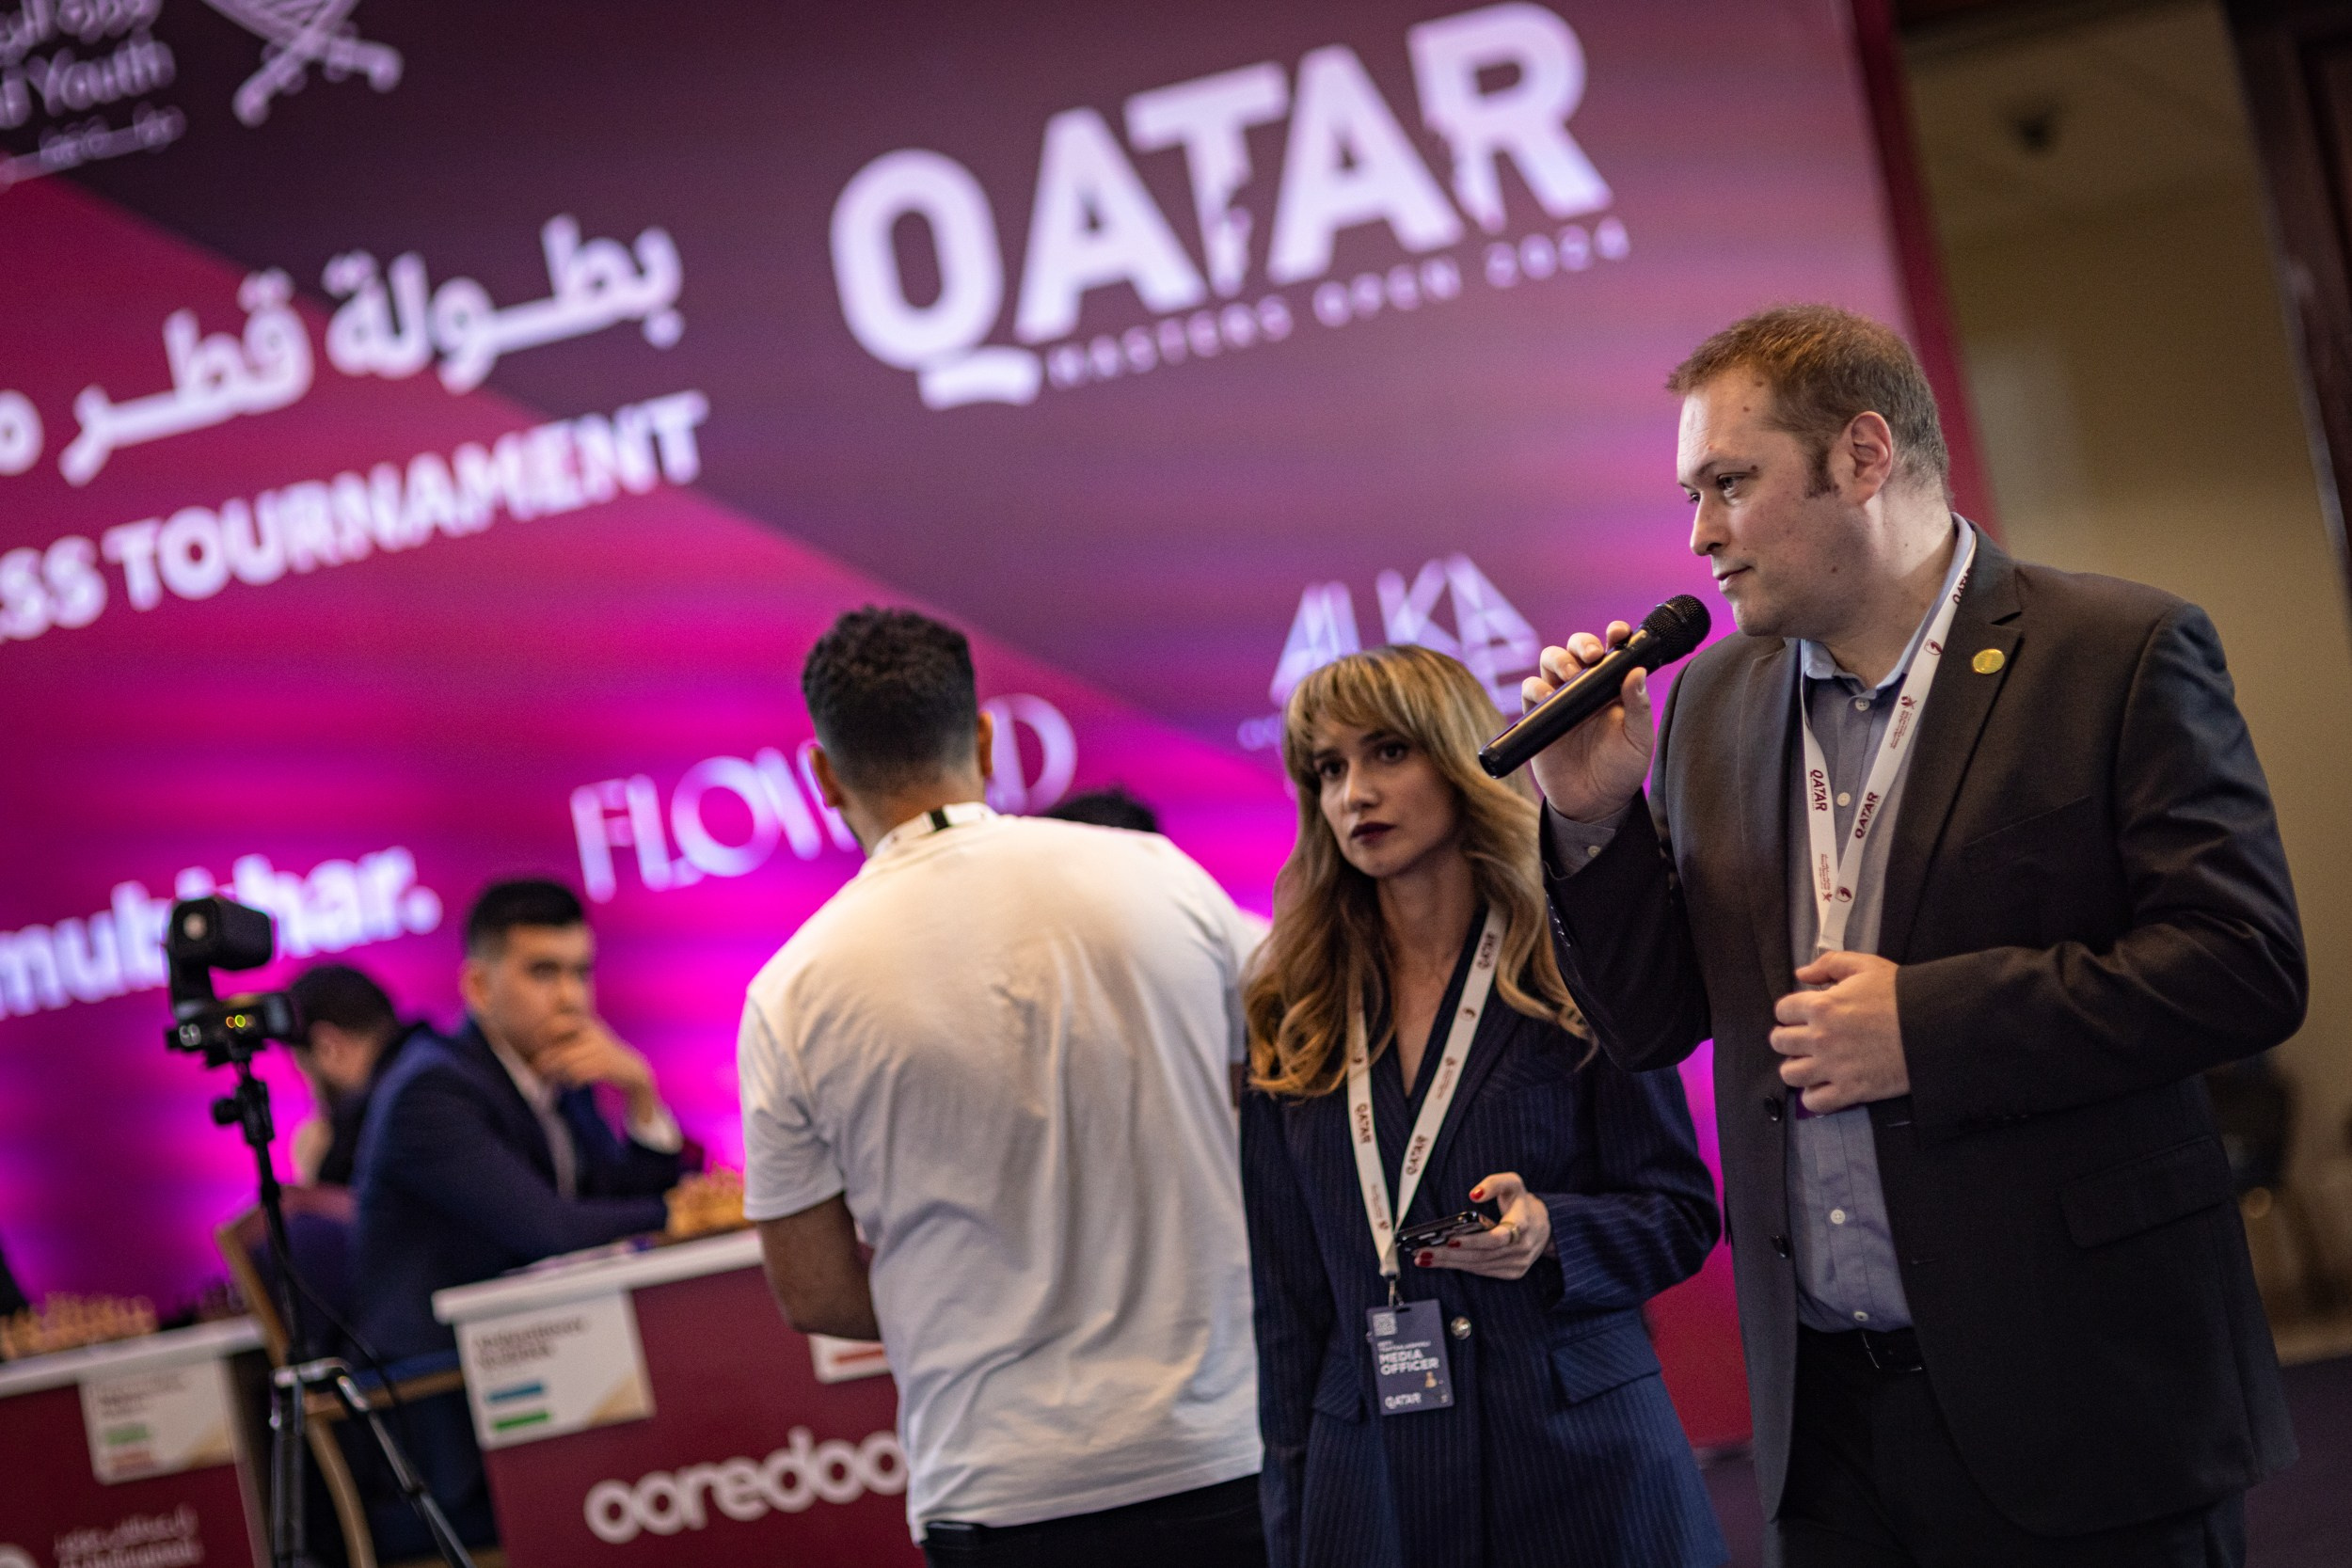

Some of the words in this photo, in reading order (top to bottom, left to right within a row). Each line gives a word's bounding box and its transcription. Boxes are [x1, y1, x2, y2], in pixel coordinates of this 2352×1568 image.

[830, 2, 1613, 409] QATAR
[323, 214, 684, 393] بطولة
[59, 268, 315, 486] قطر
[101, 388, 709, 611] TOURNAMENT
[1810, 769, 1828, 811] QATAR
[1855, 791, 1880, 839] QATAR
[1378, 1348, 1423, 1365] MEDIA
[1380, 1357, 1439, 1375] OFFICER
[1385, 1392, 1422, 1409] QATAR
[582, 1424, 908, 1545] ooredoo
